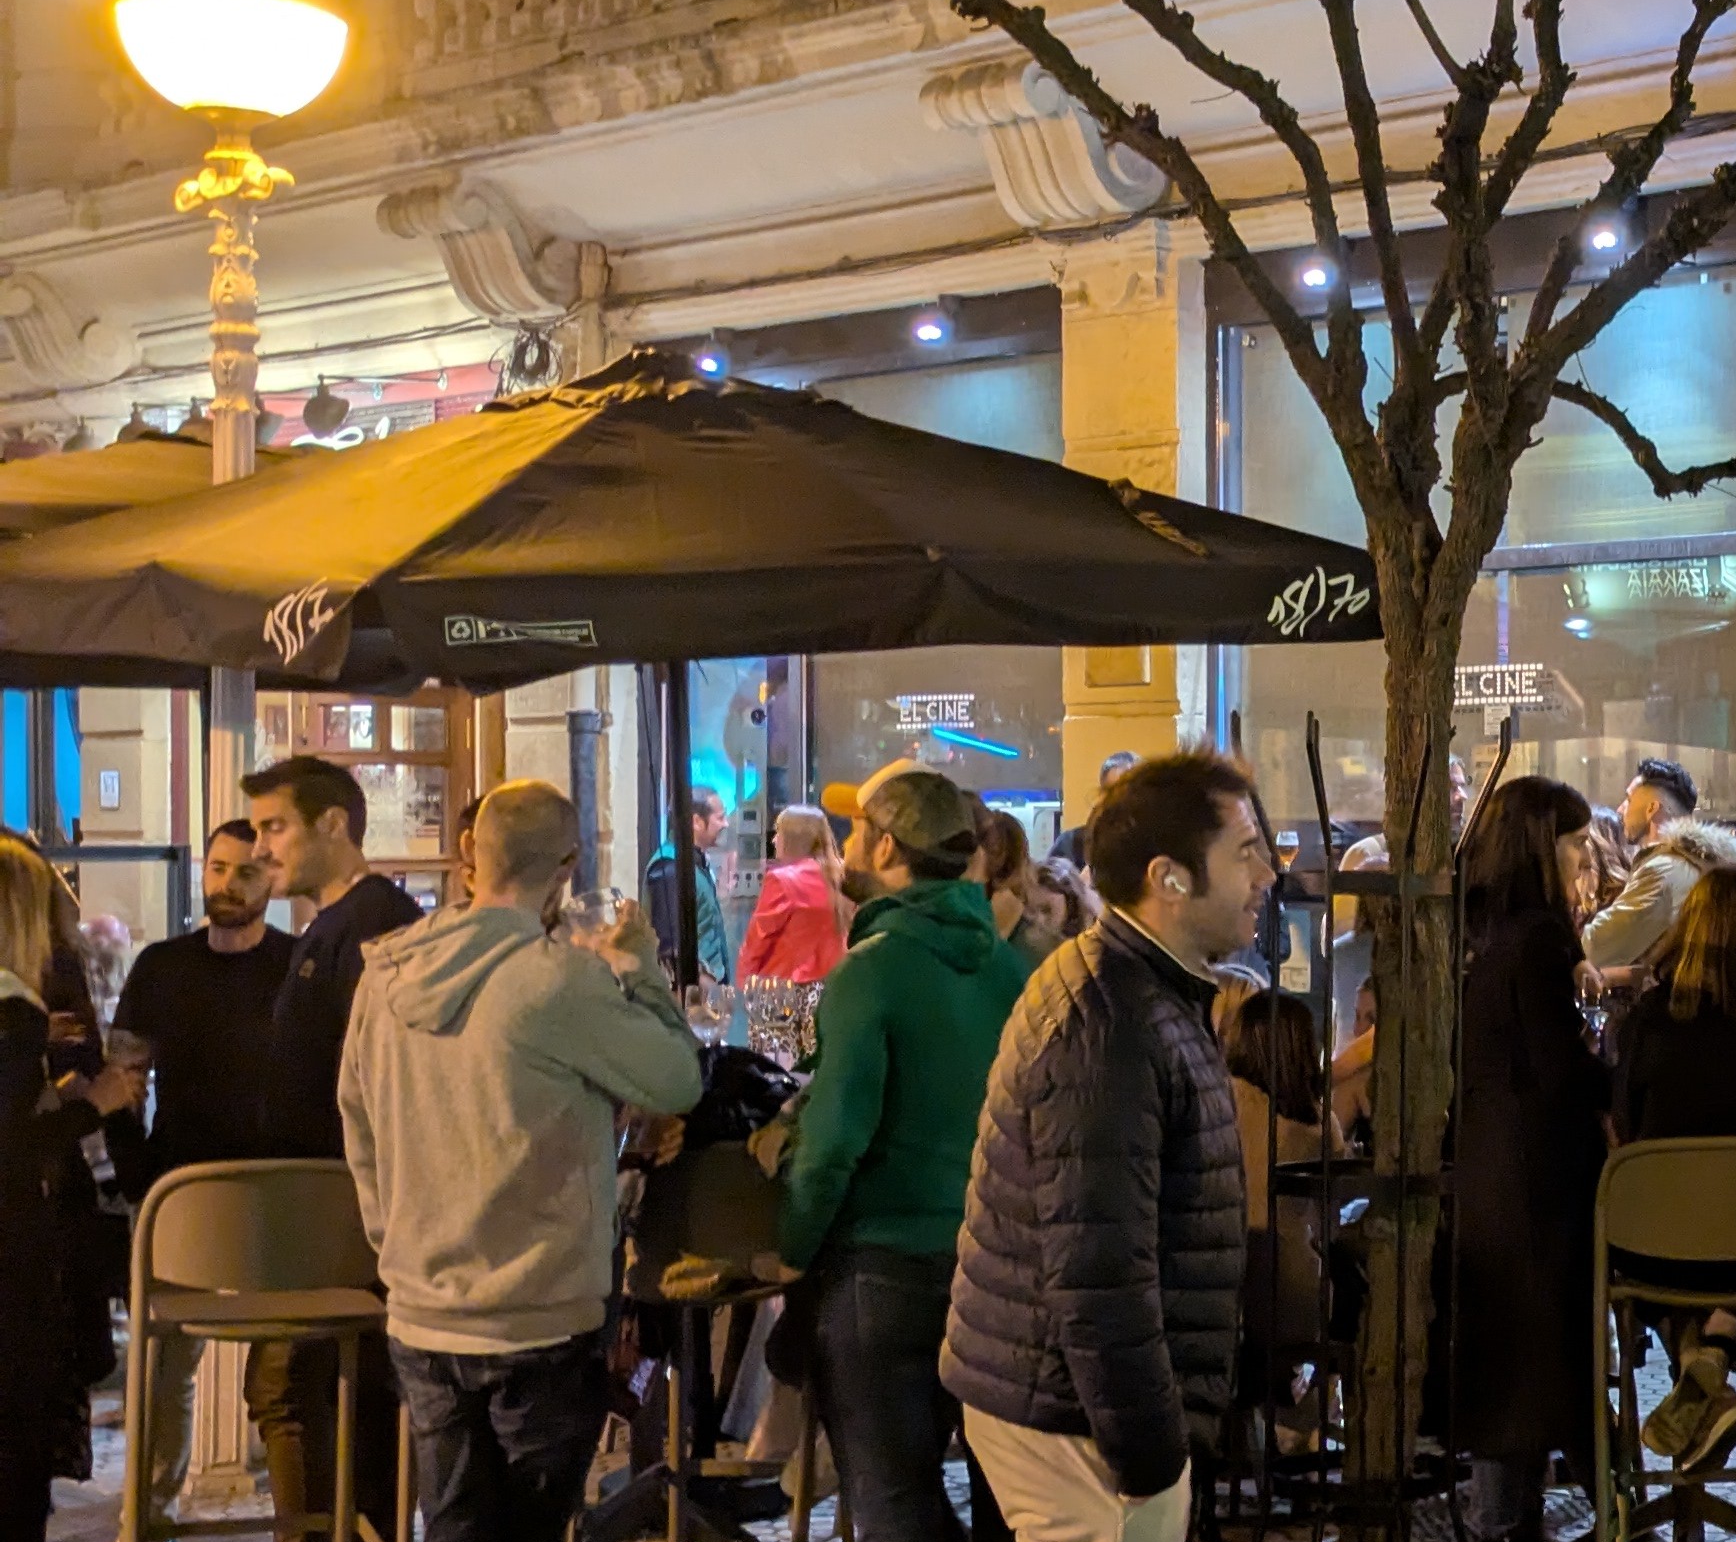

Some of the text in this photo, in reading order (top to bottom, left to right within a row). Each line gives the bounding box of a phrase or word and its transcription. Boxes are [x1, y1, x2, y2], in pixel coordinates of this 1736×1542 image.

[1454, 670, 1537, 697] L CINE
[900, 701, 970, 722] EL CINE
